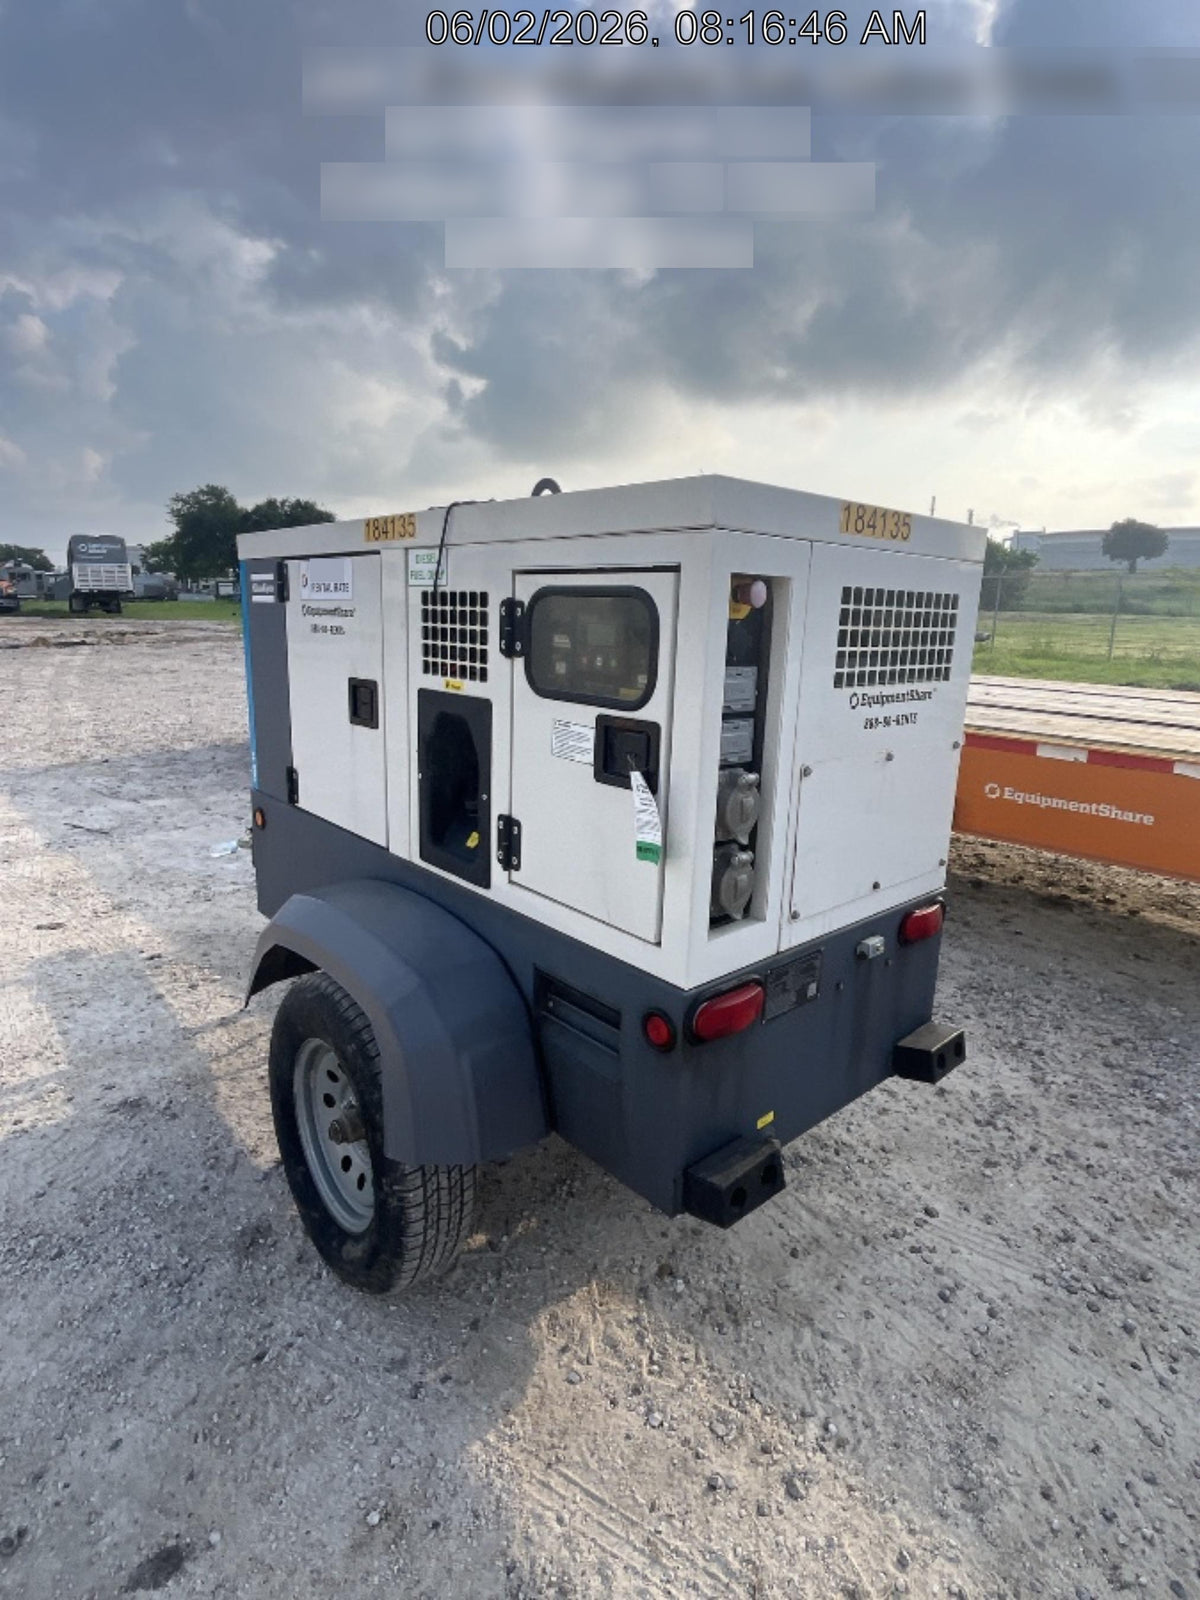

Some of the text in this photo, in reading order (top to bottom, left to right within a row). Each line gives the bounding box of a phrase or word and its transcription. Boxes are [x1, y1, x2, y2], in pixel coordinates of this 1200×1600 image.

[365, 514, 416, 541] 184135
[841, 501, 911, 540] 184135
[860, 689, 933, 708] EquipmentShare
[1003, 786, 1155, 826] EquipmentShare
